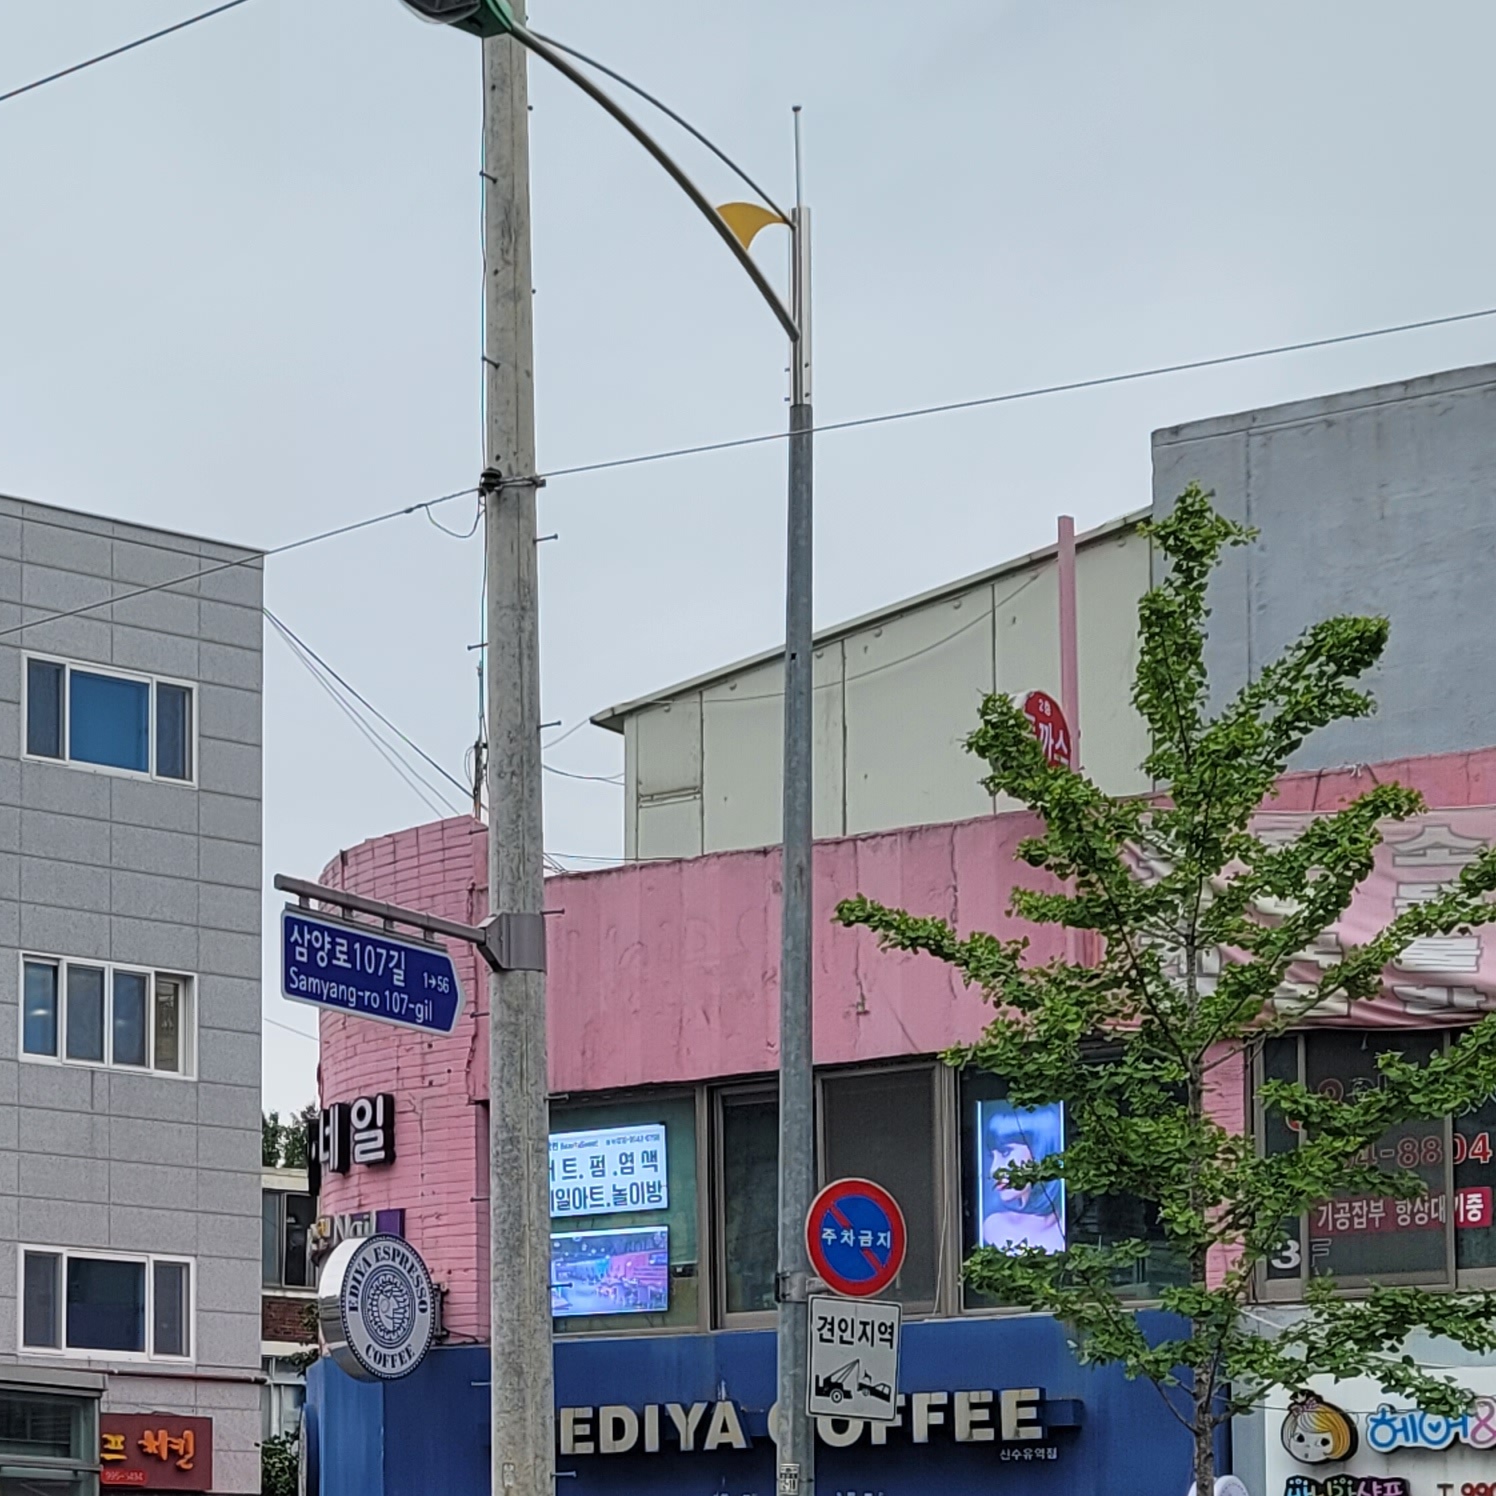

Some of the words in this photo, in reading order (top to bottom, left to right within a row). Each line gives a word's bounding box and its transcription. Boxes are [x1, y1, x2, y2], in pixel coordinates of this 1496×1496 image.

[289, 924, 406, 987] 삼양로107길
[289, 967, 381, 1008] Samyang-ro
[384, 990, 433, 1024] 107-gil
[821, 1228, 891, 1250] 주차금지
[373, 1246, 429, 1314] ESPRESSO
[365, 1343, 416, 1369] COFFEE
[816, 1315, 895, 1350] 견인지역
[559, 1400, 752, 1455] EDIYA
